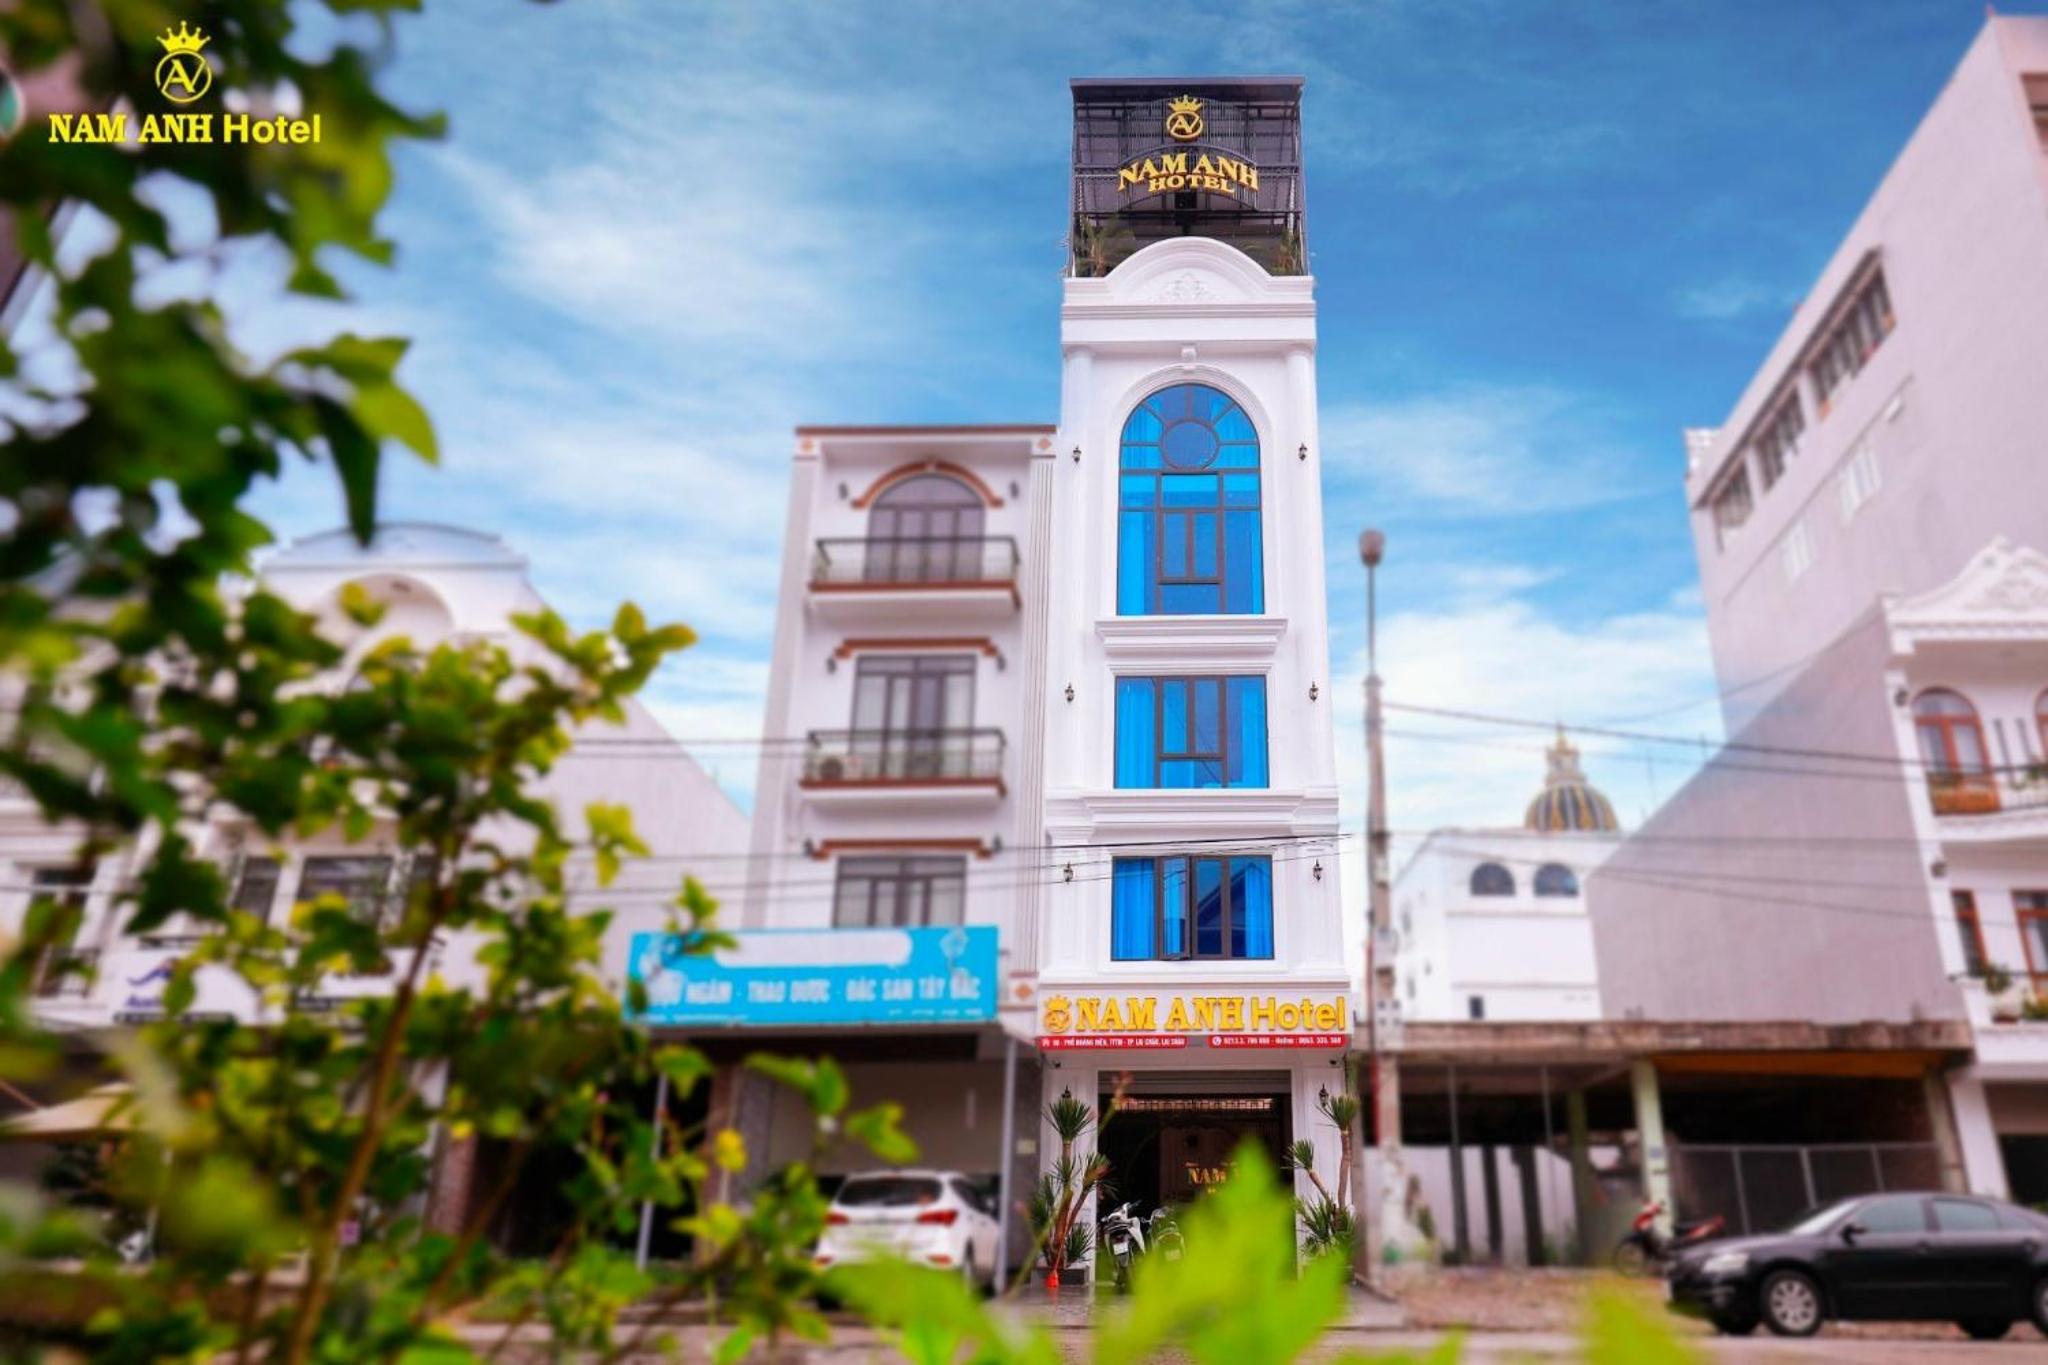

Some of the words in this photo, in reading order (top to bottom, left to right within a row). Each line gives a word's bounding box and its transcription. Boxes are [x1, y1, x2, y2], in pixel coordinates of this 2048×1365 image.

[1118, 152, 1187, 192] NAM
[1193, 153, 1259, 192] ANH
[1148, 174, 1235, 194] HOTEL
[1075, 996, 1156, 1031] NAM
[1164, 996, 1244, 1031] ANH
[1250, 996, 1346, 1031] Hotel
